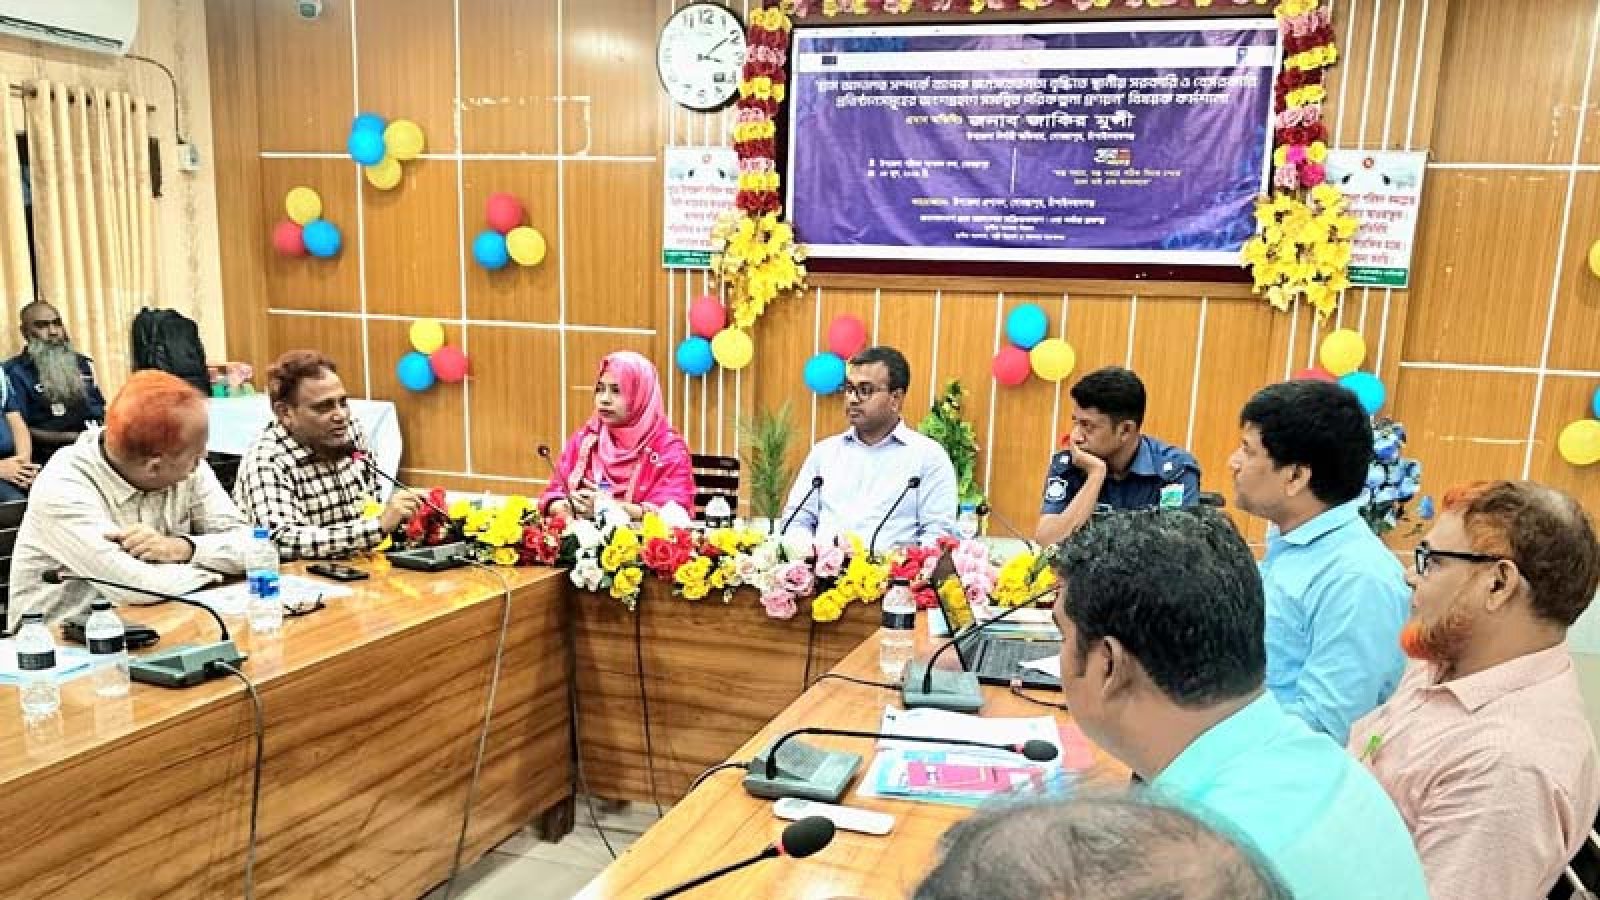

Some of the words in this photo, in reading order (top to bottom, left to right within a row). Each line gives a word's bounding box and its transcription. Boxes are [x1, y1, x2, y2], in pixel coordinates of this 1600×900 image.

[698, 8, 714, 25] 12
[966, 114, 1020, 128] জনাব
[1024, 109, 1087, 128] জাকির
